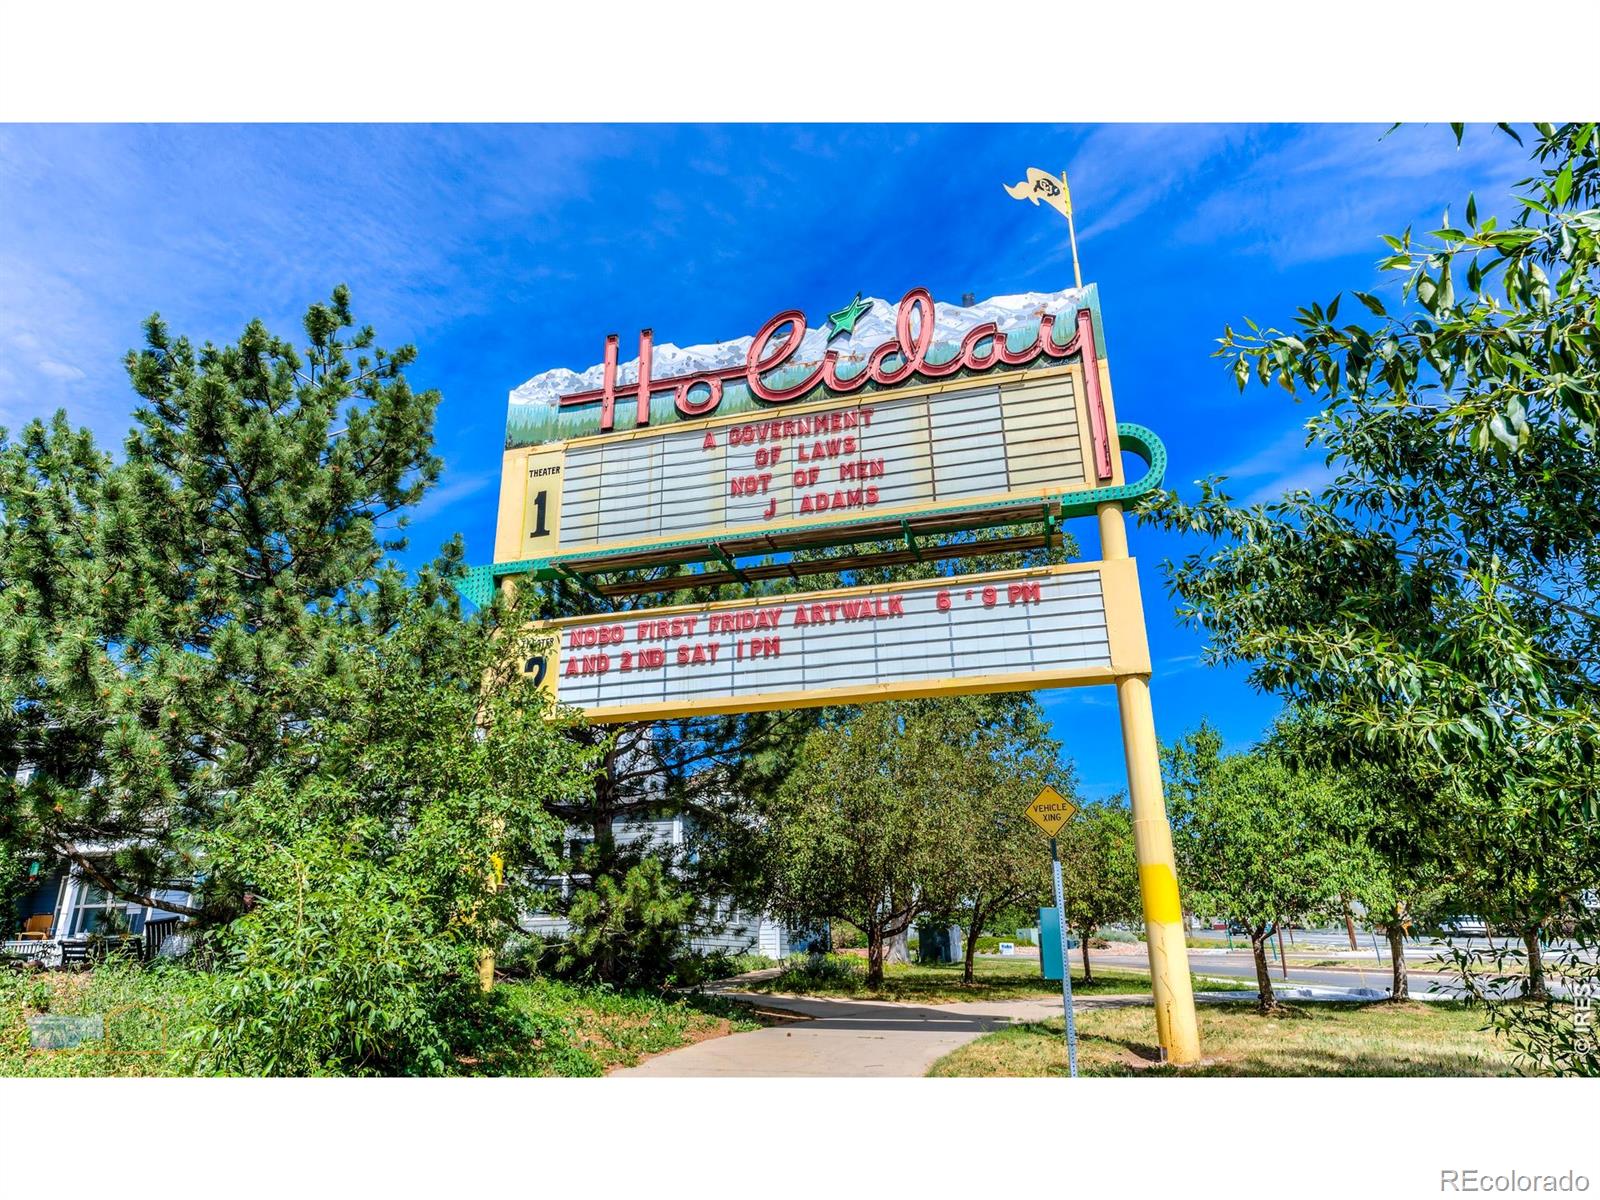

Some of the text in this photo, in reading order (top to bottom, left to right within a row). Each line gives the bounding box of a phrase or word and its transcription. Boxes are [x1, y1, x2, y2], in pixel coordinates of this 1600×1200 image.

[558, 287, 1113, 481] Holiday
[703, 408, 874, 450] A GOVERNMENT
[755, 435, 856, 469] OF LAWS
[529, 466, 561, 478] THEATER
[730, 457, 885, 498] NOT OF MEN
[530, 490, 550, 538] 1
[763, 485, 880, 520] J ADAMS
[570, 625, 624, 648] NOBO
[637, 616, 697, 643] FIRST
[708, 607, 782, 636] FRIDAY
[793, 595, 904, 627] ARTWALK
[936, 590, 951, 612] 6
[981, 585, 999, 608] 9
[1007, 581, 1041, 608] PM
[565, 653, 610, 678] AND
[676, 642, 720, 667] SAT
[1033, 803, 1067, 812] VEHICLE
[1043, 813, 1061, 821] XING
